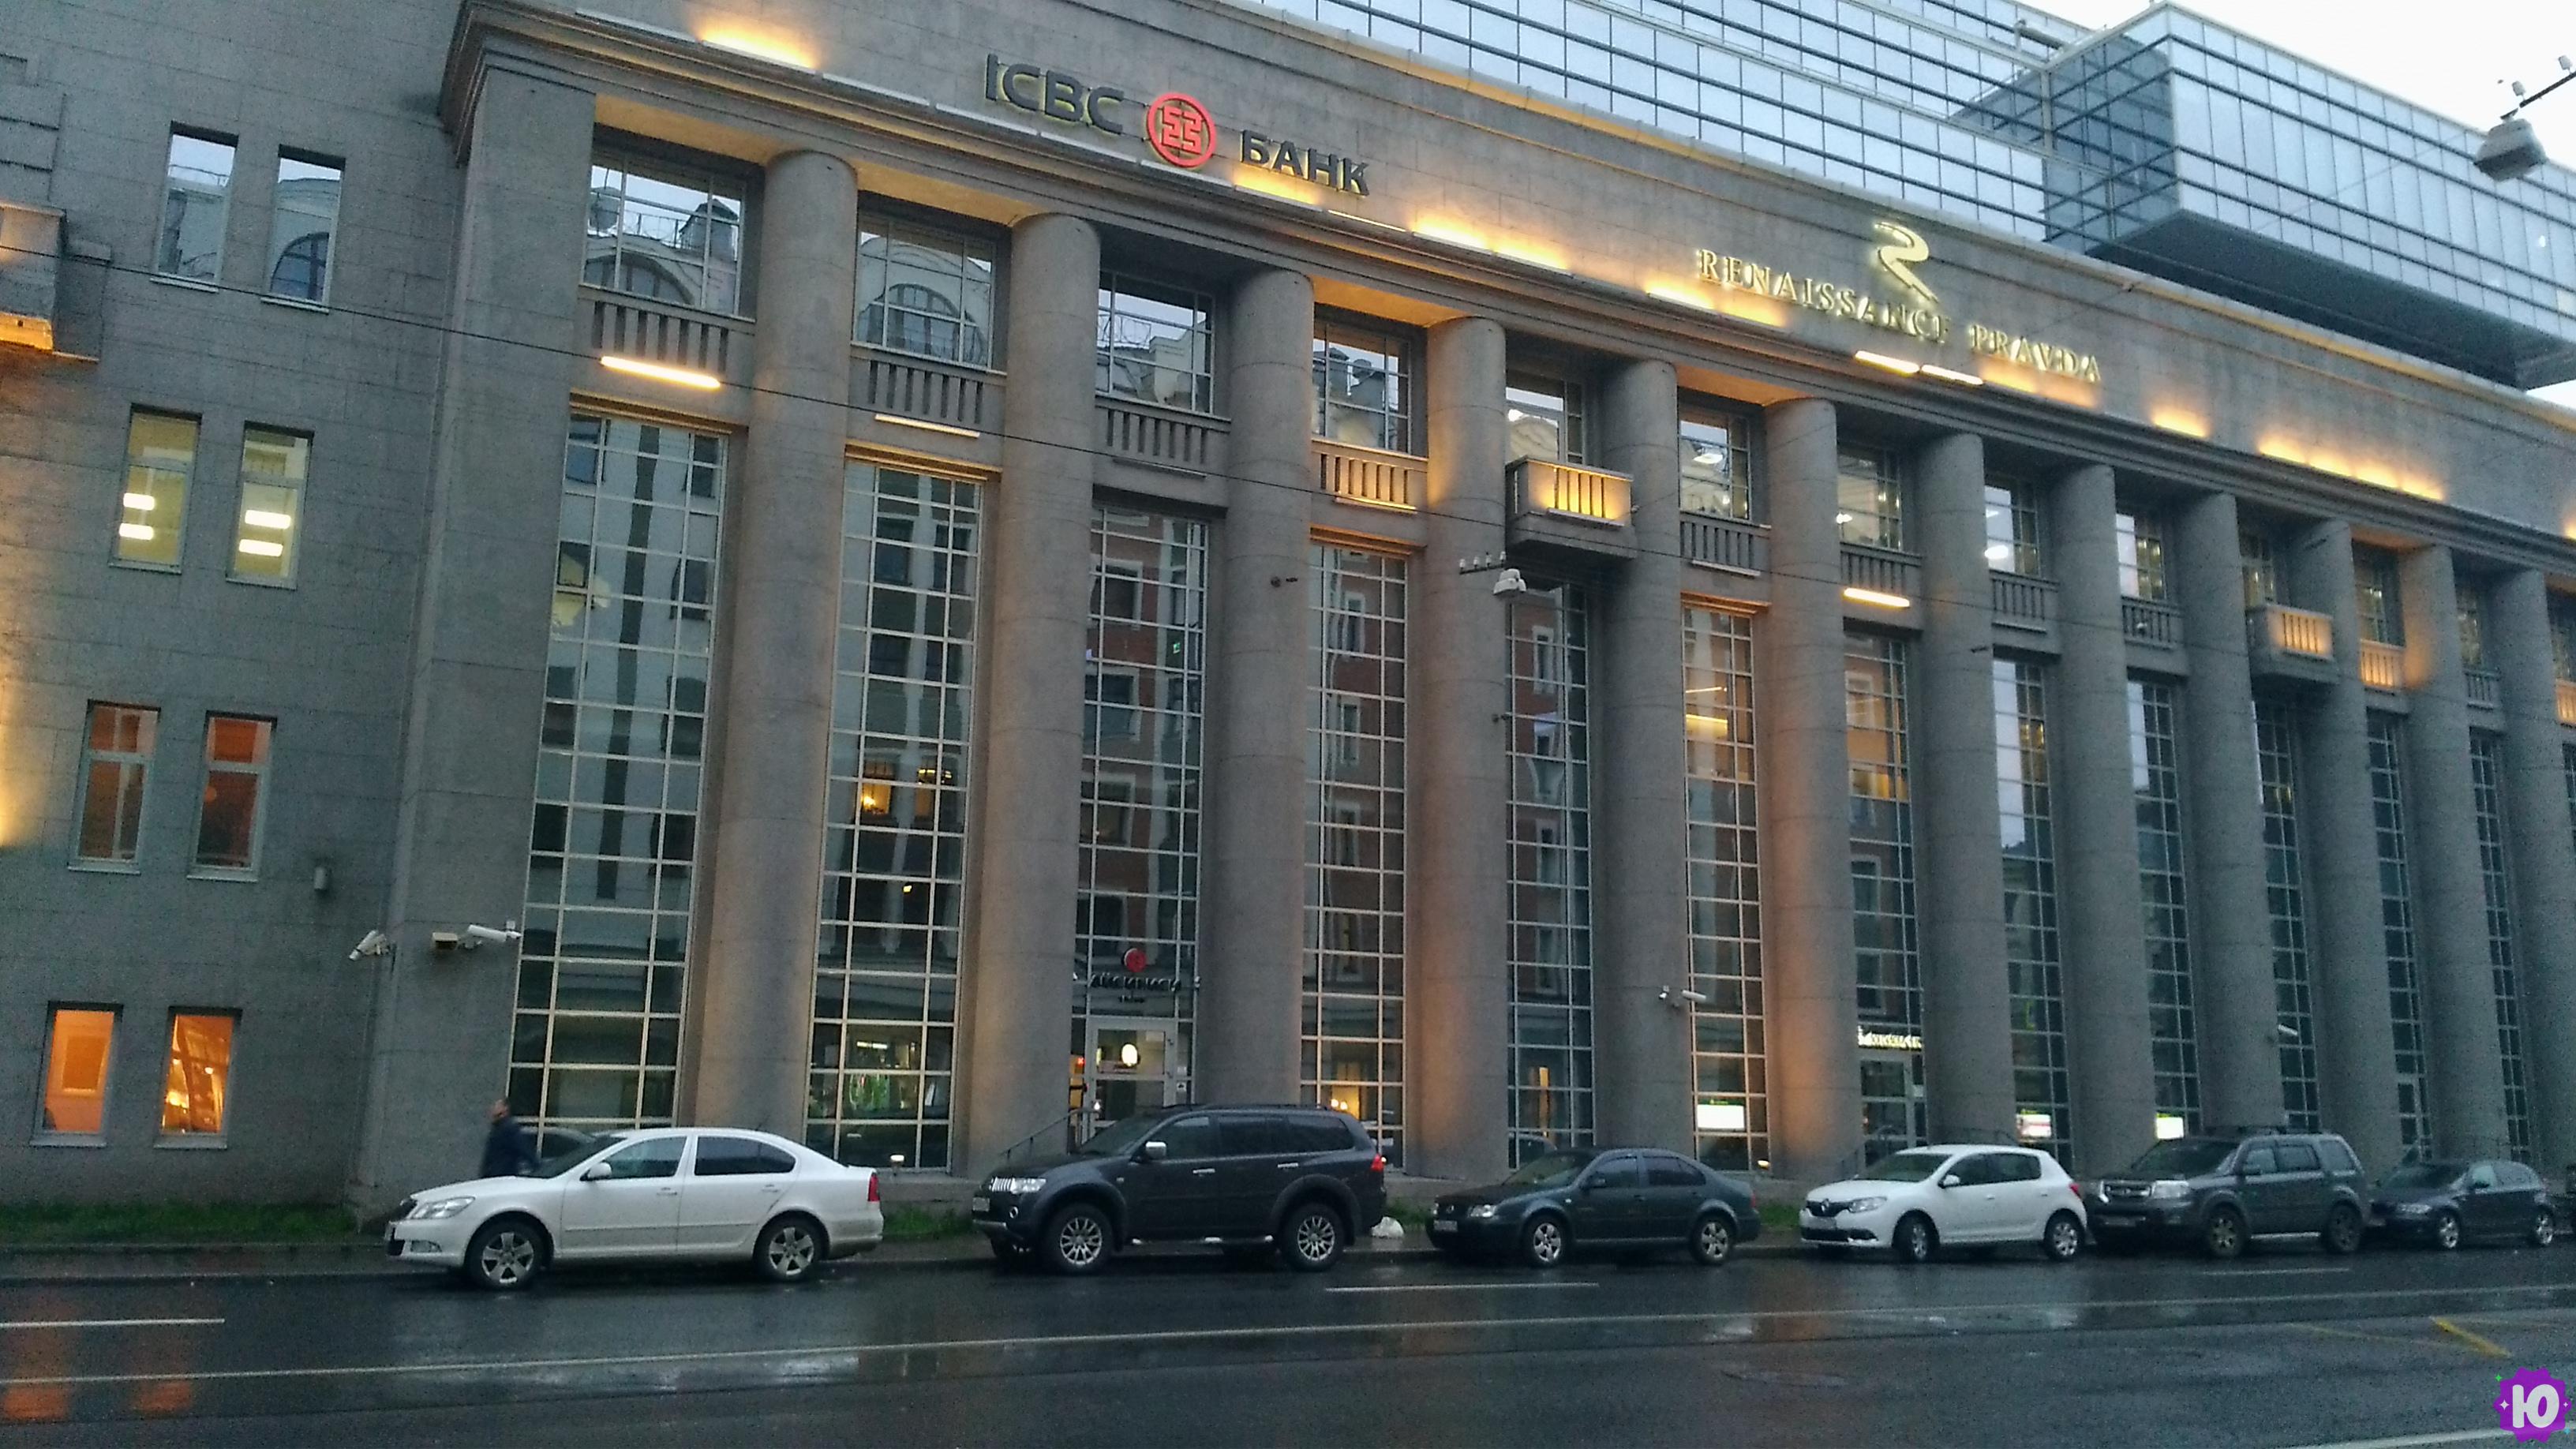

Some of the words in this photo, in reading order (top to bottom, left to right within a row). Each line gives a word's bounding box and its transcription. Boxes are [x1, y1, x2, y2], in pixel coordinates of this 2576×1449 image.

[986, 53, 1124, 135] ICBC
[1240, 129, 1369, 196] БАНК
[1697, 249, 1951, 343] RENAISSANCE
[1971, 324, 2102, 384] PRAVDA
